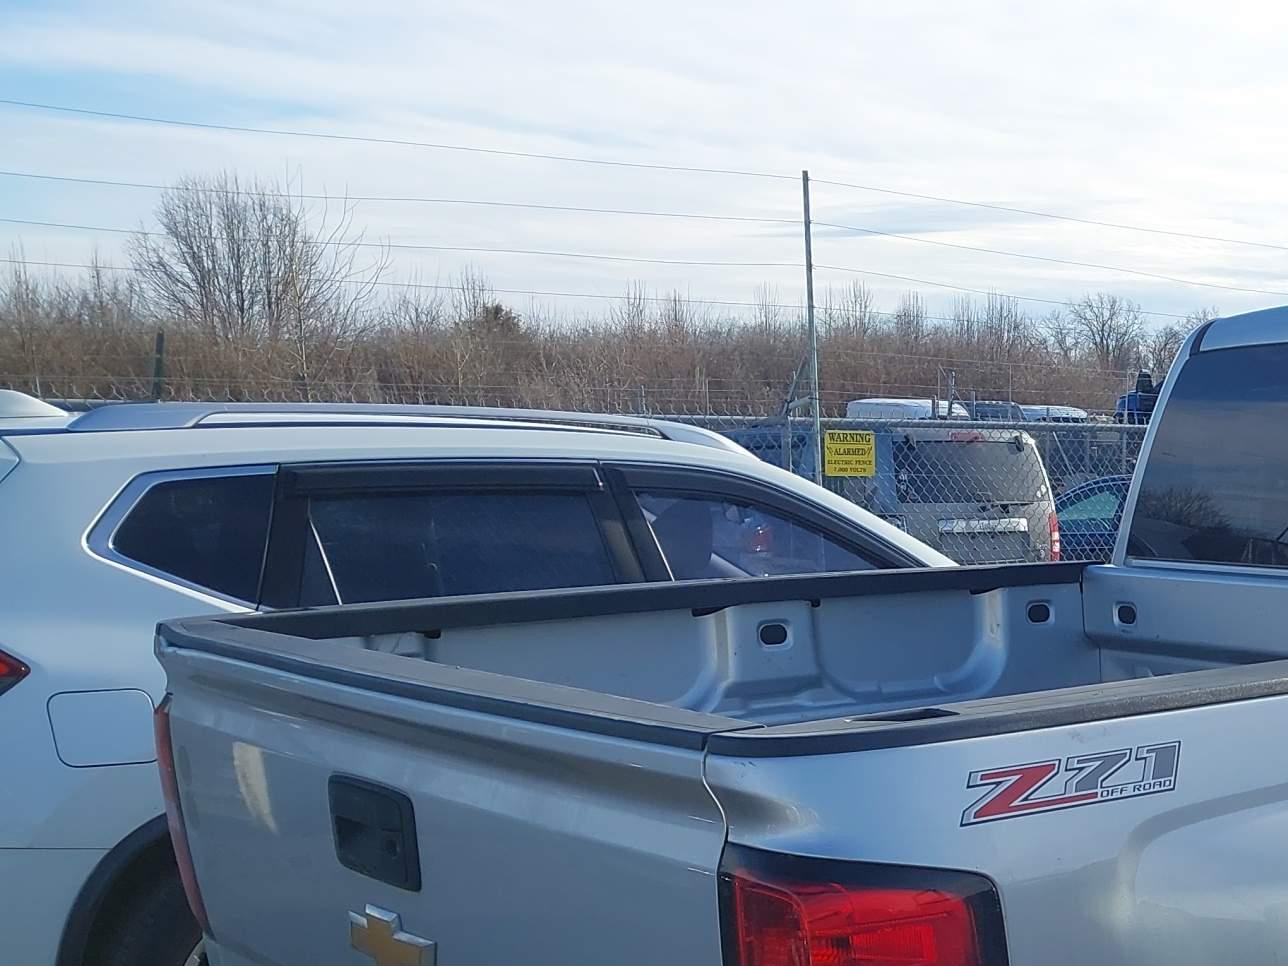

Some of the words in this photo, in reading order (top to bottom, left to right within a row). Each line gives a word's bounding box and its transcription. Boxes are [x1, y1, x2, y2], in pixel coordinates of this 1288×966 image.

[828, 432, 872, 443] WARNING
[834, 447, 866, 456] ALARMED
[960, 740, 1182, 828] Z71
[1100, 786, 1128, 798] OFF
[1132, 779, 1172, 793] ROAD
